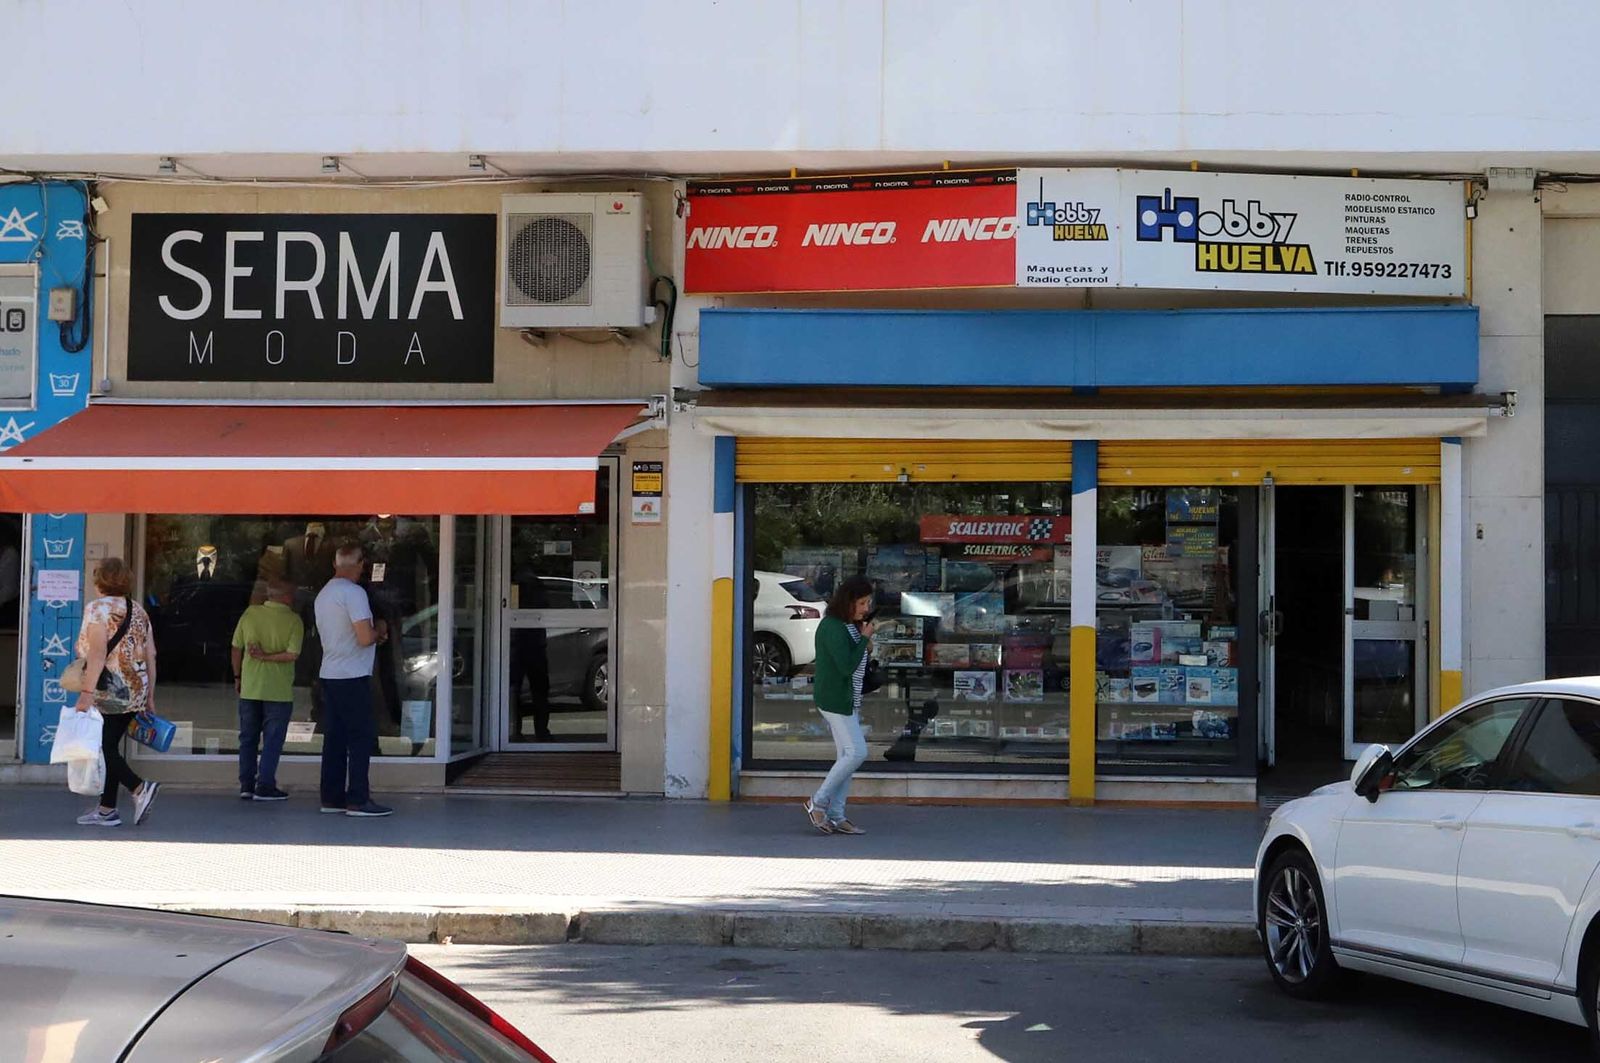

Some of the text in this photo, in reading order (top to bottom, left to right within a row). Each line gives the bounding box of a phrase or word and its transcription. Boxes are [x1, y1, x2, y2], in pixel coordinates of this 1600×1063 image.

[1345, 194, 1411, 202] RADIO-CONTROL
[1027, 202, 1101, 226] Hobby
[1345, 205, 1435, 215] MODELISMO ESTATICO
[1137, 188, 1297, 243] Hobby
[1345, 216, 1386, 224] PINTURAS
[687, 216, 1016, 249] NINCO NINCO NINCO
[1053, 224, 1108, 240] HUELVA
[1345, 227, 1390, 235] MAQUETAS
[1345, 246, 1394, 254] REPUESTOS
[1196, 242, 1317, 274] HUELVA
[1027, 265, 1108, 274] Maquetas y
[158, 230, 464, 320] SERMA
[189, 331, 426, 365] MODA
[58, 379, 69, 388] 30
[948, 522, 1025, 536] SCALEXTRIC
[53, 544, 64, 553] 30
[963, 545, 1019, 555] SCALEXTRIC
